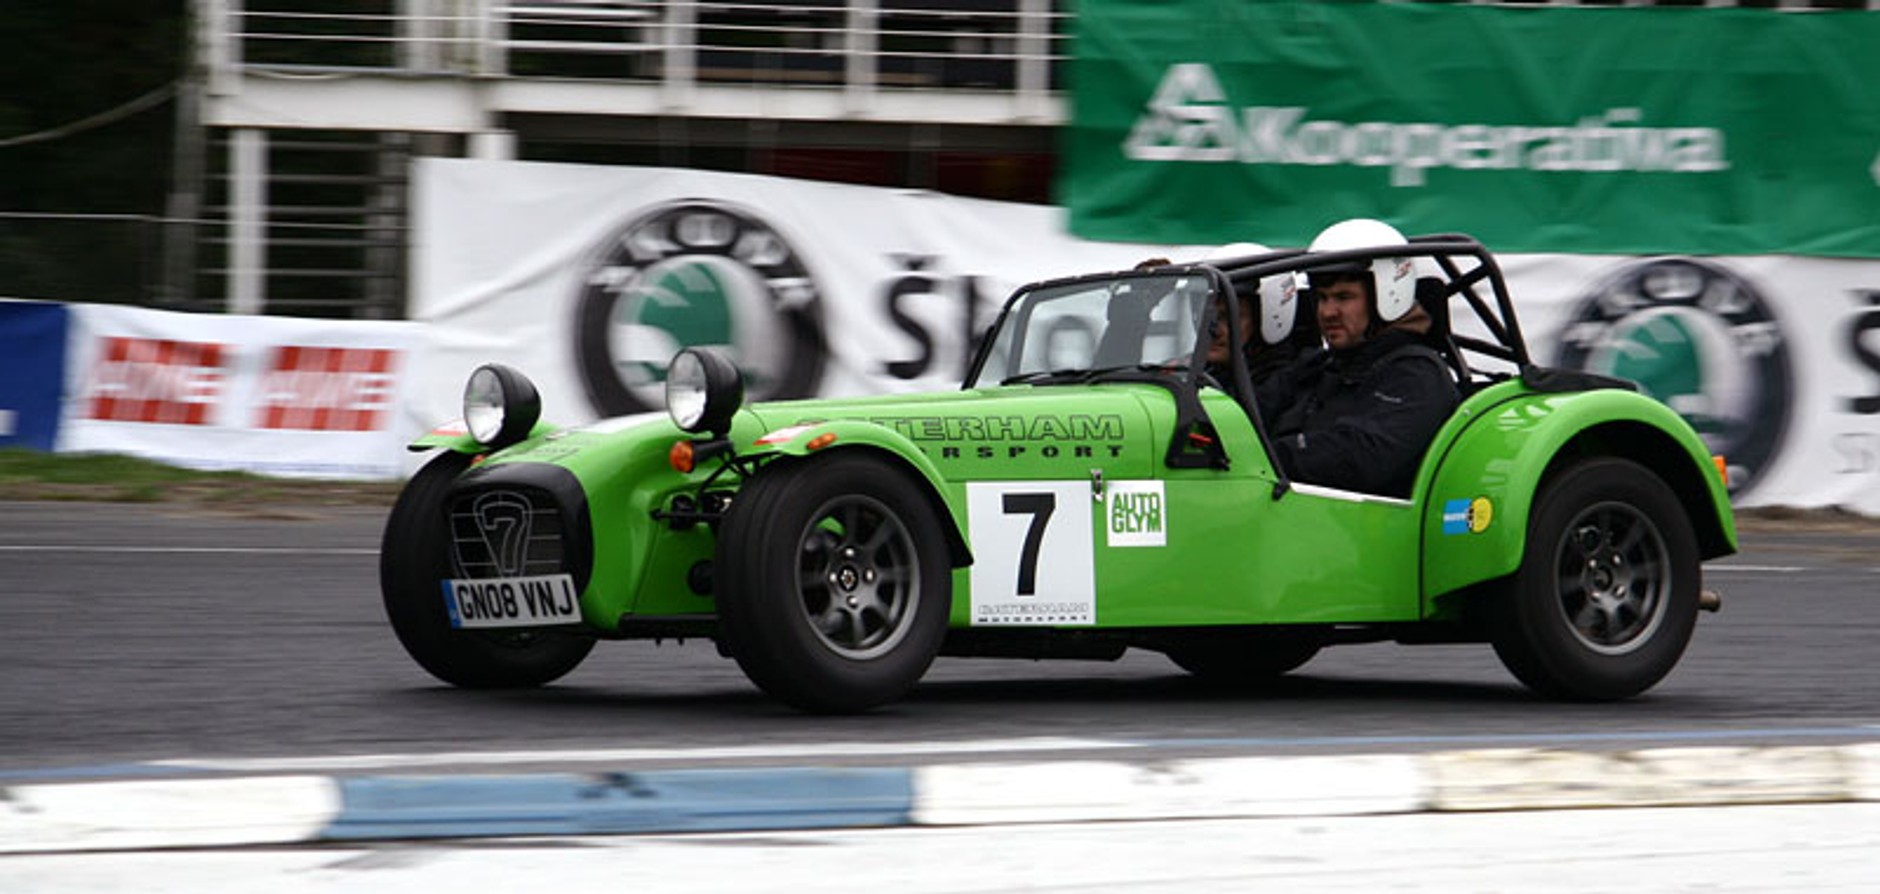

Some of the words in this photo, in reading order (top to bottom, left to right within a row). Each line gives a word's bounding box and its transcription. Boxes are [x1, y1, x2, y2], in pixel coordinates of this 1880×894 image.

[1240, 106, 1728, 187] Kooperativa
[870, 414, 1125, 441] TERHAM
[942, 444, 1124, 459] RSPORT
[1112, 492, 1160, 513] AUTO
[1112, 512, 1162, 533] GLYM
[1002, 493, 1056, 596] 7
[456, 583, 519, 620] GN08
[519, 578, 574, 617] VNJ
